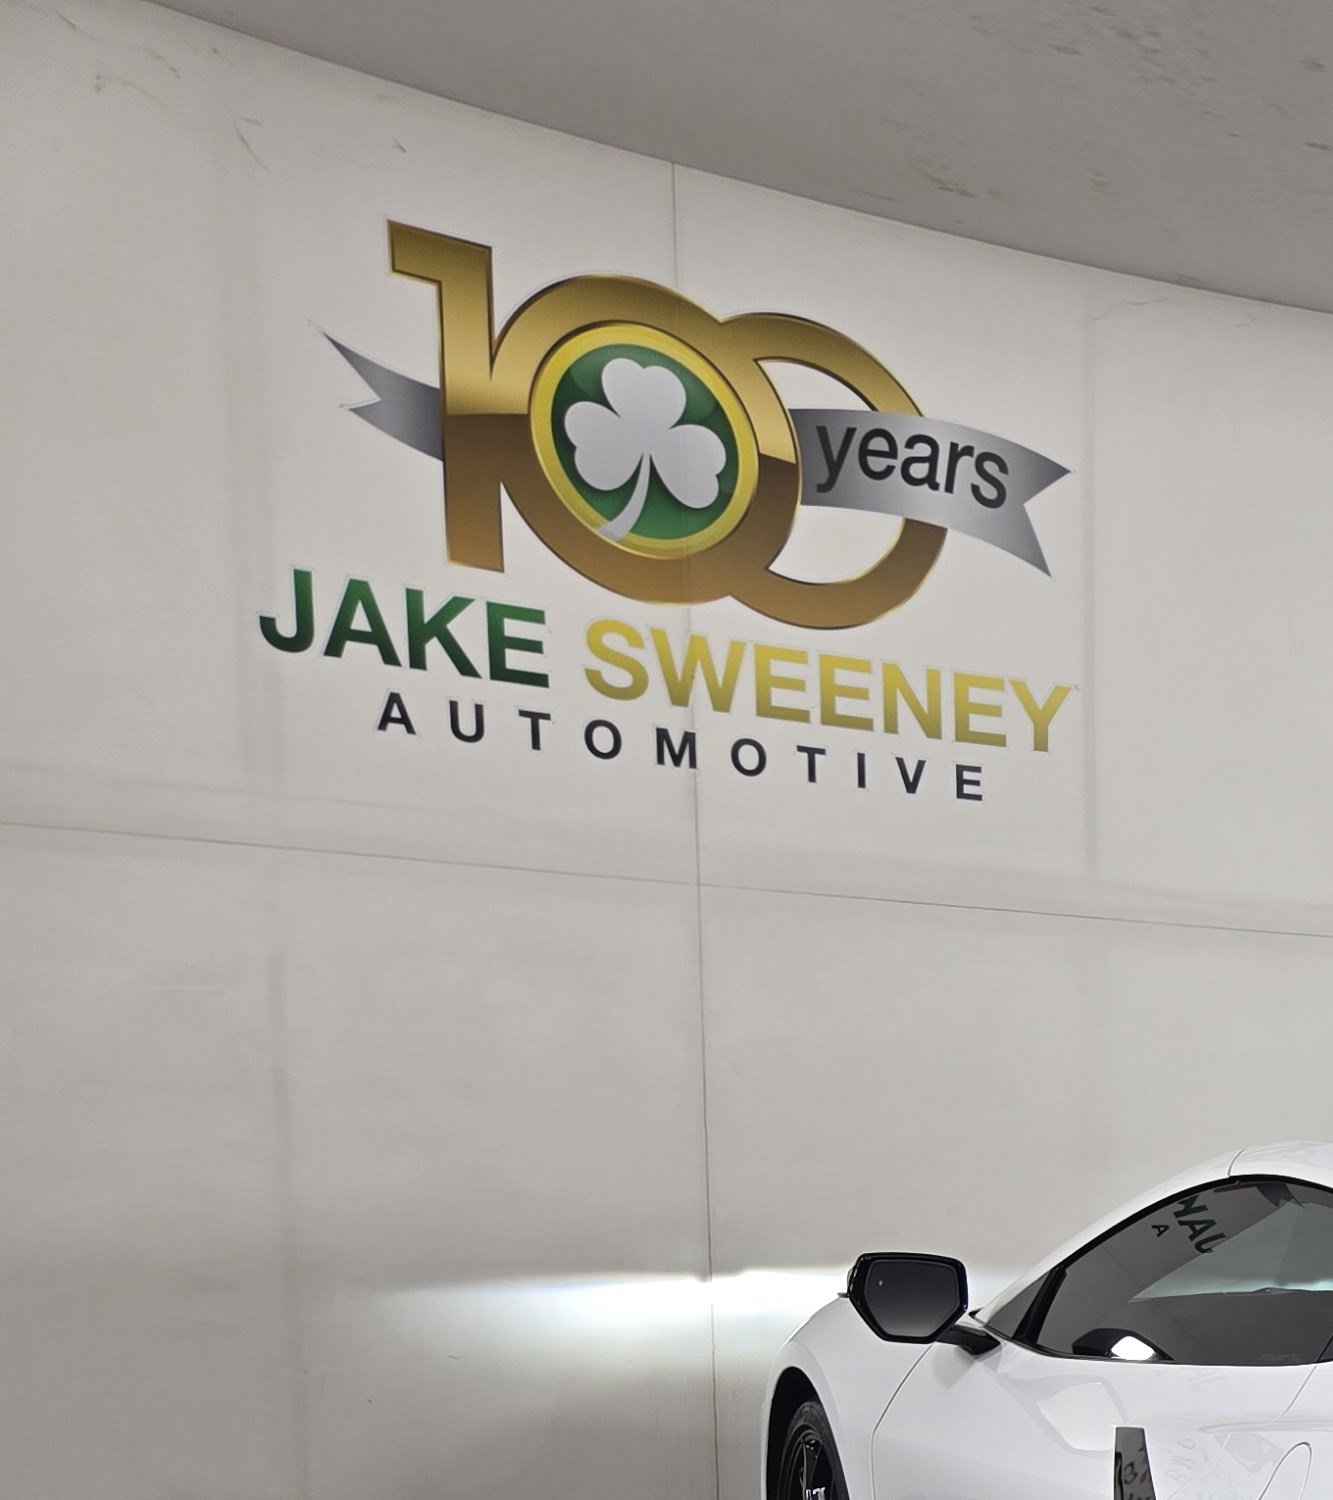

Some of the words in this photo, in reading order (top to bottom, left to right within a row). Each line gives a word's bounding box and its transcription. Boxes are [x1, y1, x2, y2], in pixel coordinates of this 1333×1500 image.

[386, 219, 948, 630] 100
[815, 421, 1010, 509] years
[259, 568, 551, 689] JAKE
[584, 619, 1073, 753] SWEENEY
[376, 692, 984, 801] AUTOMOTIVE
